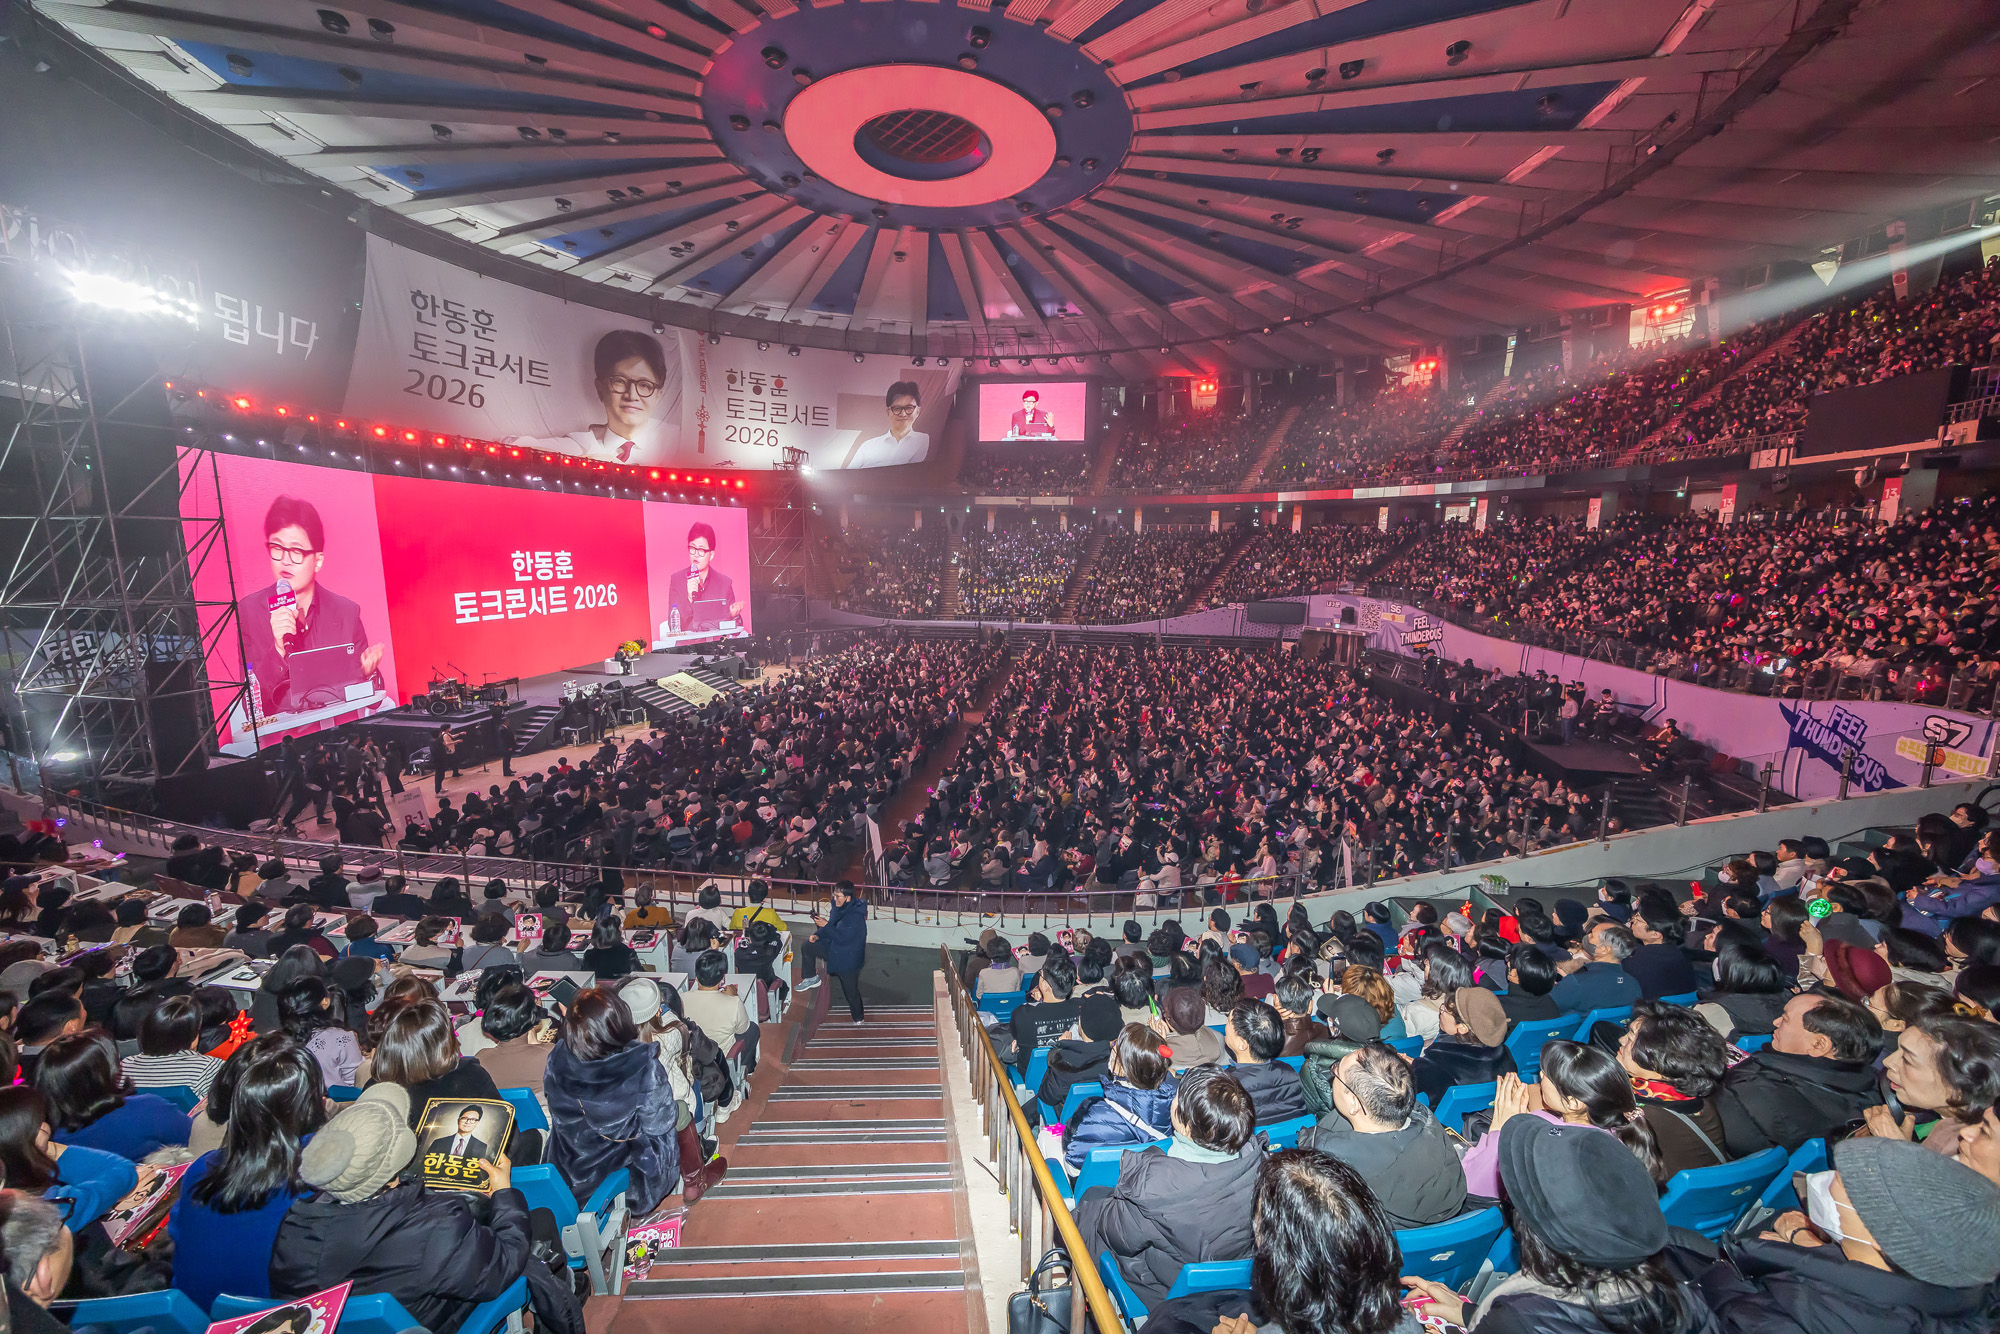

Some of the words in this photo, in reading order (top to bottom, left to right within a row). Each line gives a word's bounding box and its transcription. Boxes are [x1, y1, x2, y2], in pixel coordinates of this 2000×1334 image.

[214, 291, 319, 361] 됩니다
[410, 289, 497, 342] 한동훈
[409, 331, 551, 387] 토크콘서트
[403, 369, 485, 408] 2026
[699, 360, 707, 394] CONCERT
[725, 368, 788, 397] 한동훈
[726, 398, 829, 426] 토크콘서트
[725, 425, 779, 447] 2026
[1722, 498, 1733, 508] 13
[1884, 488, 1898, 499] 13
[511, 550, 573, 581] 한동훈
[454, 586, 568, 624] 토크콘서트
[573, 583, 618, 610] 2026
[1390, 604, 1402, 614] S6
[1400, 627, 1443, 646] THUNDEROUS
[1413, 615, 1430, 631] FEEL
[1828, 706, 1867, 747] FEEL
[1923, 717, 1971, 748] S7
[1793, 710, 1886, 789] THUNDEOUS
[423, 1152, 481, 1179] 한동훈
